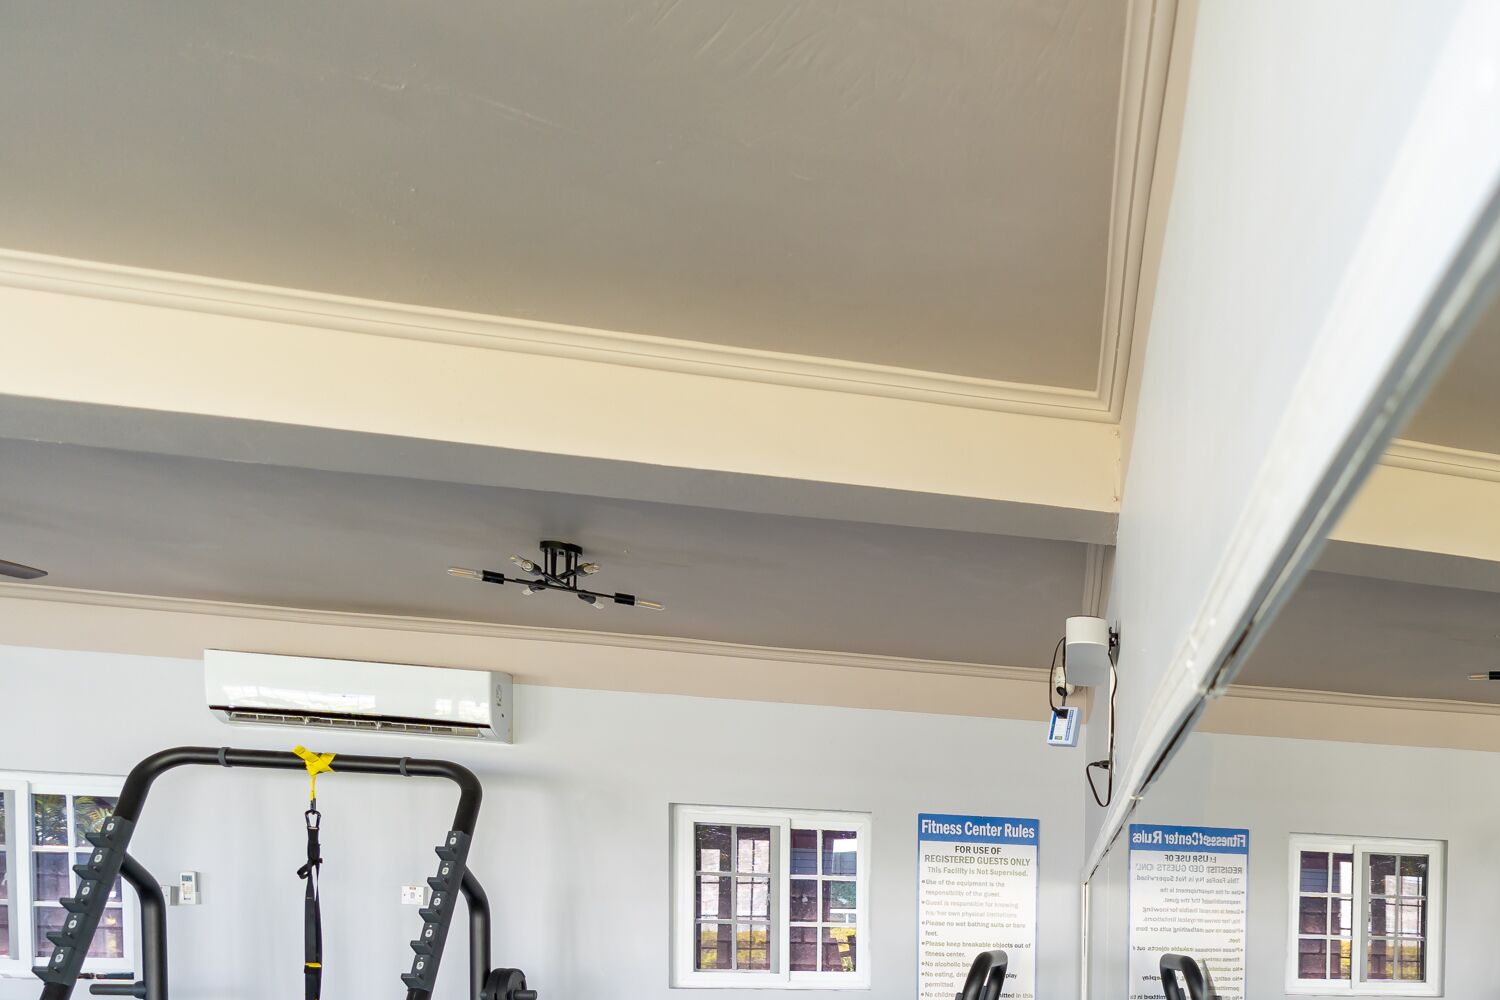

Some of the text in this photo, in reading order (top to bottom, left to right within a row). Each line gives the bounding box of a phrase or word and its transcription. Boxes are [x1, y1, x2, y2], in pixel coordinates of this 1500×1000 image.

[922, 820, 1034, 838] Fitness Center Rules
[925, 855, 975, 864] REGISTERED
[977, 857, 1008, 865] GUESTS
[944, 867, 967, 876] Facility
